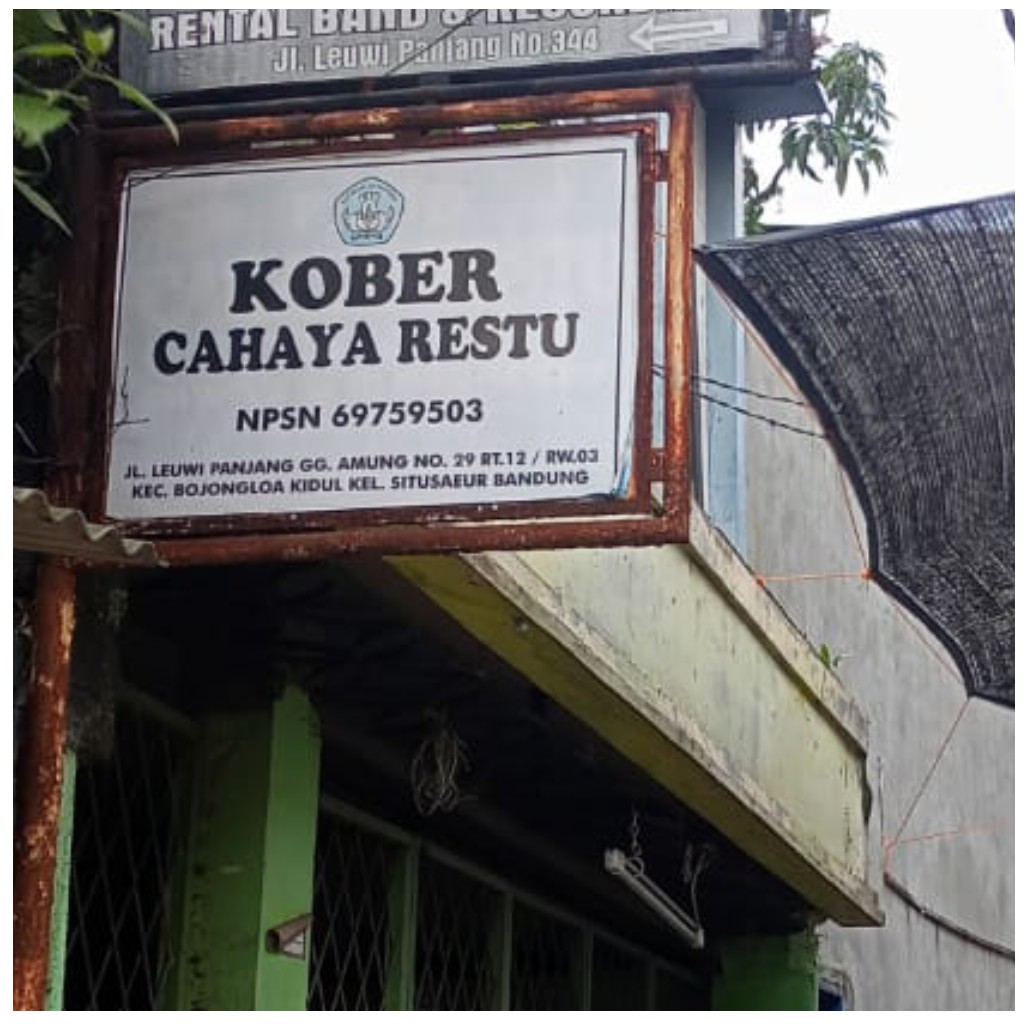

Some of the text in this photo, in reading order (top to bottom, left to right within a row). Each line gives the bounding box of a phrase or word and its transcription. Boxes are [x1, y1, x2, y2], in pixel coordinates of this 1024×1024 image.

[149, 9, 297, 52] RENTAL
[314, 42, 389, 70] Leuwi
[509, 27, 598, 57] No.344
[229, 248, 502, 314] KOBER
[153, 312, 579, 375] CAHAYA RESTU
[235, 398, 484, 432] NPSN 69759503
[124, 463, 146, 480] JL.
[151, 462, 204, 478] LEUWI
[209, 458, 294, 476] PANJANG
[299, 457, 333, 473] GG.
[337, 453, 408, 472] AMUNG
[413, 453, 447, 469] NO.
[453, 452, 475, 468] 29
[132, 469, 590, 500] KEC. BOJONGLOA KIDUL KEL. SITUSAEUR BANDUNG
